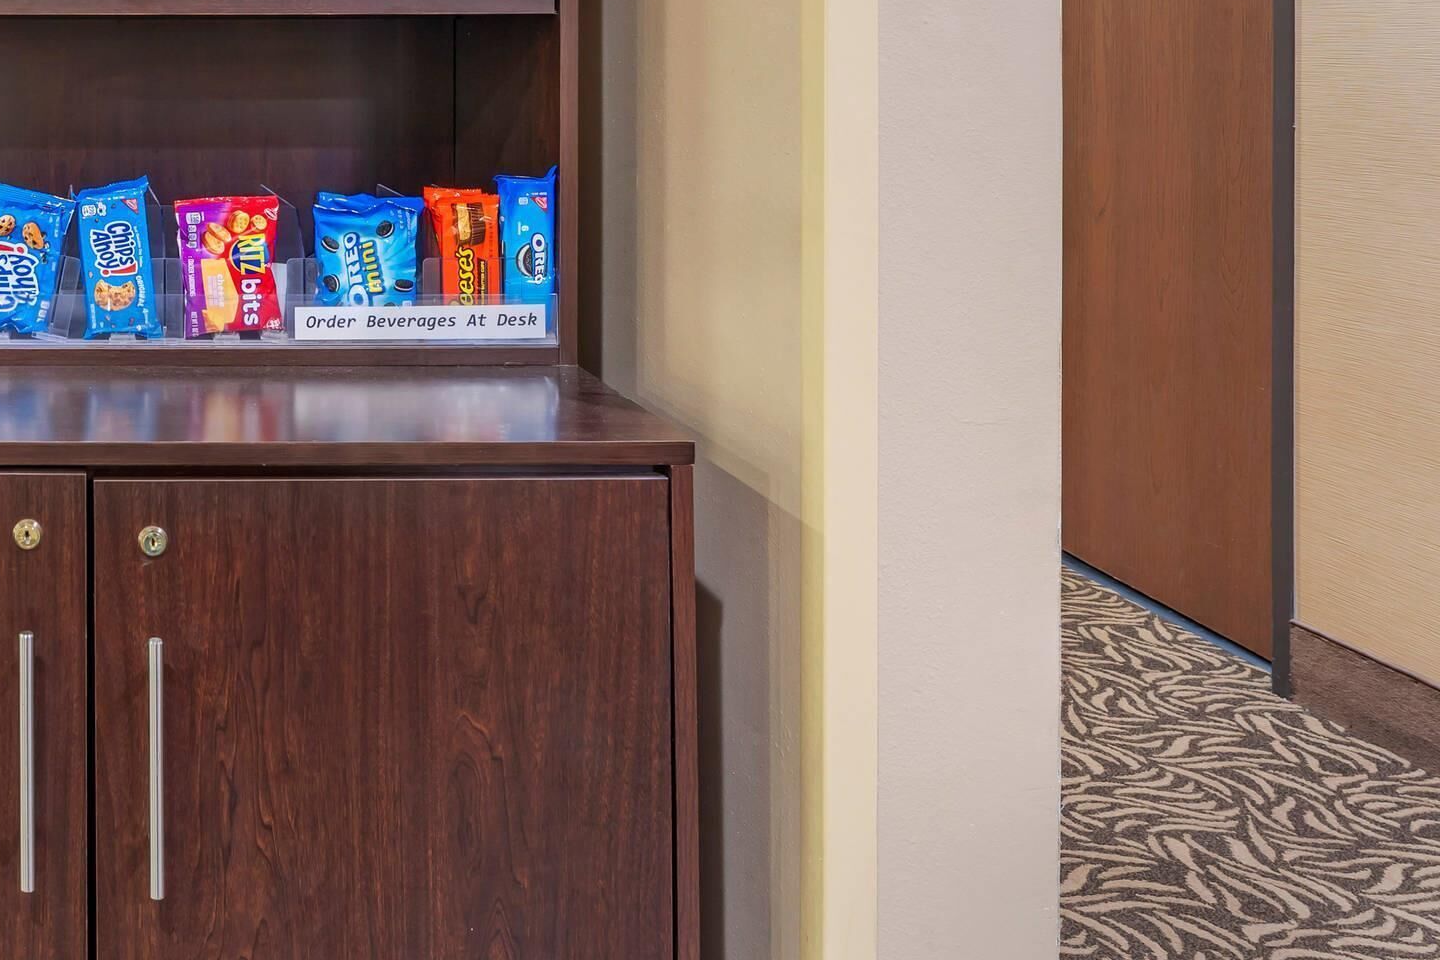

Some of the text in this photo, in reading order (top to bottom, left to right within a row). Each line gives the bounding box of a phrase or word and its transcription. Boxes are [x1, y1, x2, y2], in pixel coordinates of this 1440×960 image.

[106, 221, 135, 266] Chips
[237, 234, 266, 275] RITZ
[362, 240, 383, 294] mini
[343, 232, 368, 306] OREO
[450, 246, 474, 306] eese's
[240, 278, 262, 326] bits
[307, 312, 537, 330] Order Beverages At Desk
